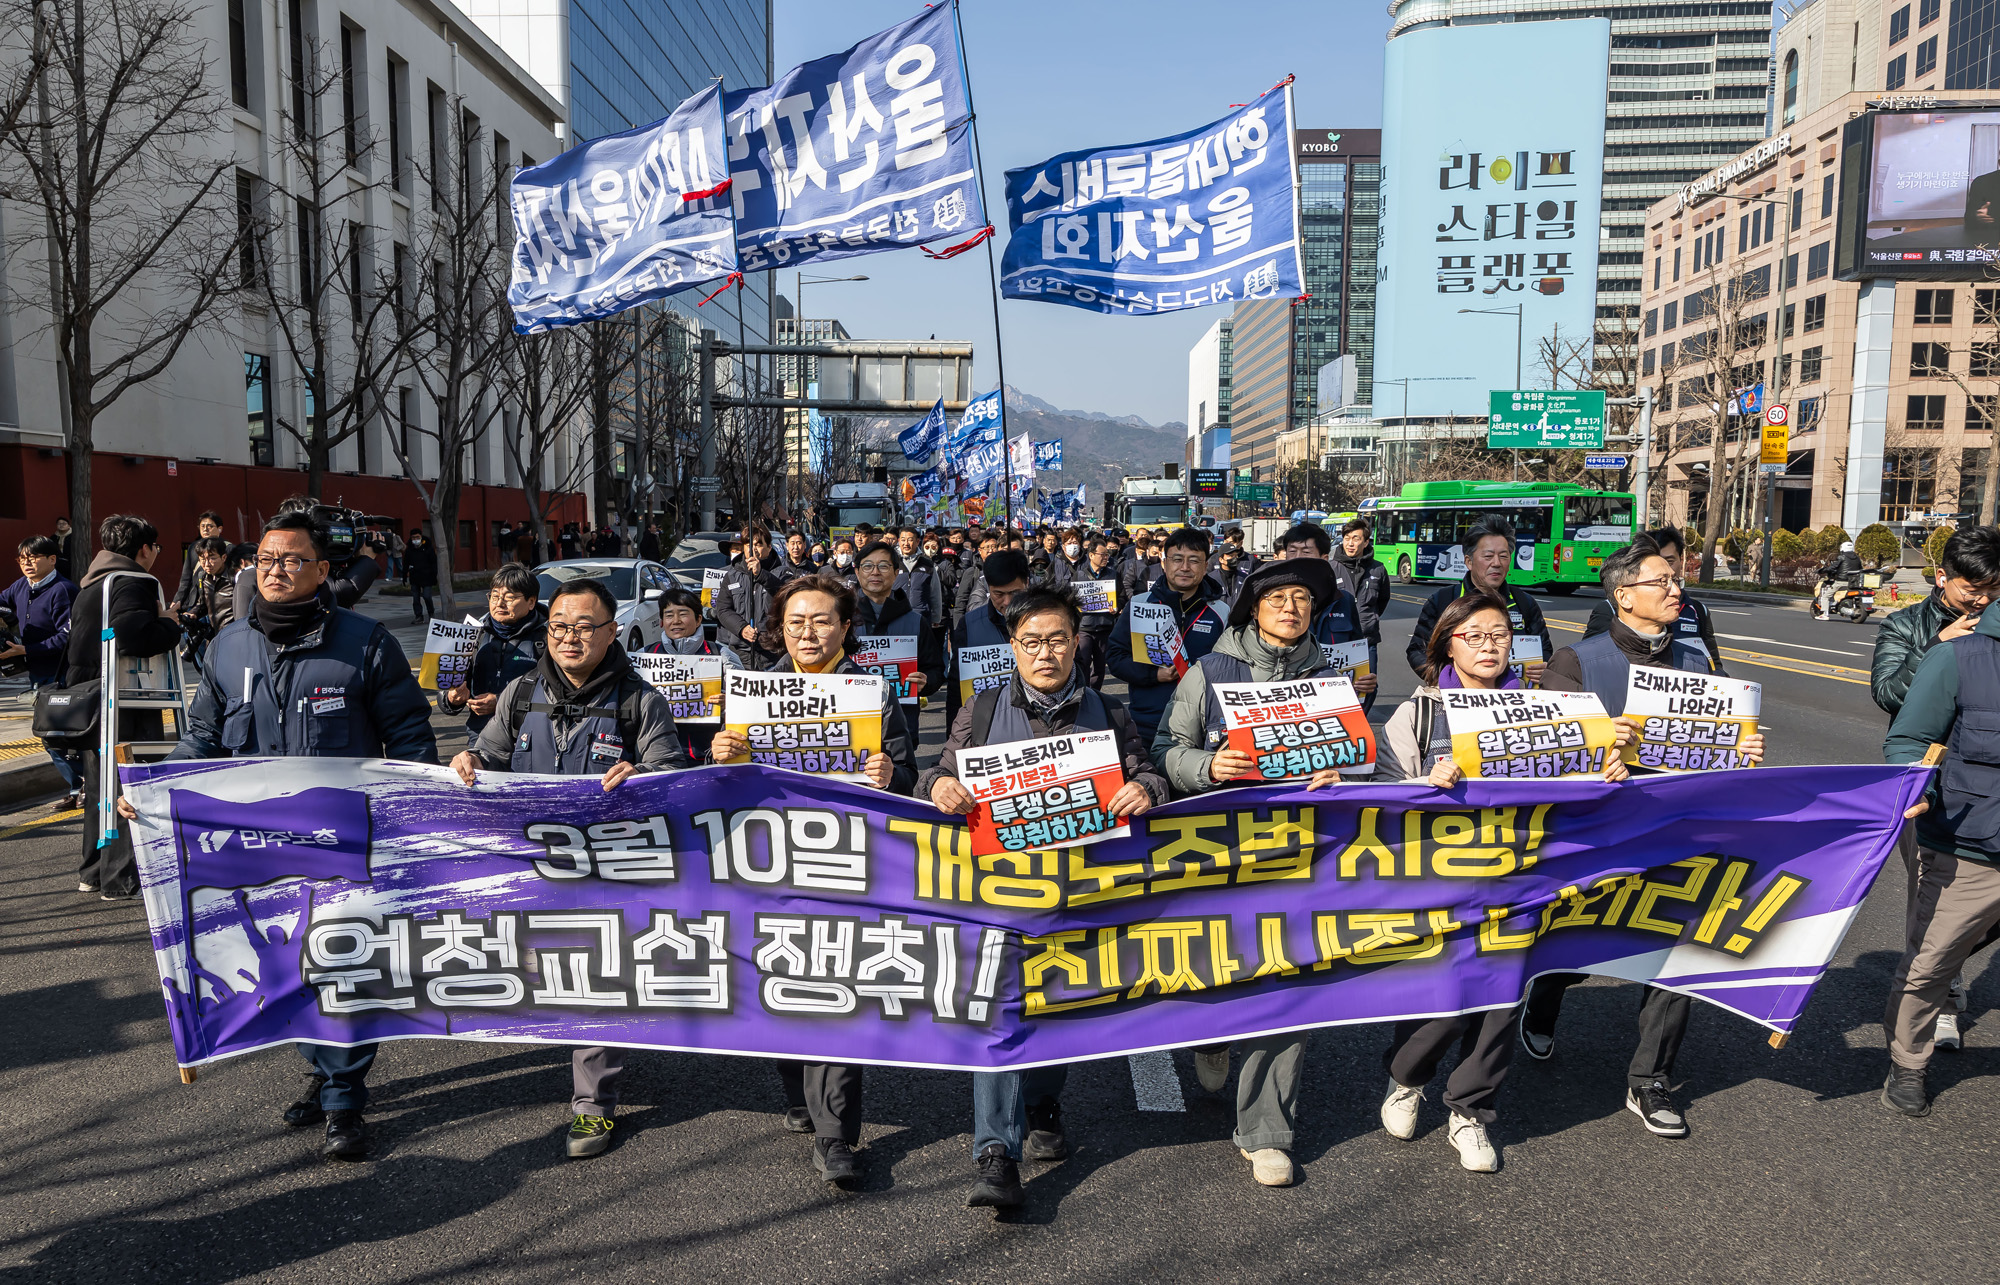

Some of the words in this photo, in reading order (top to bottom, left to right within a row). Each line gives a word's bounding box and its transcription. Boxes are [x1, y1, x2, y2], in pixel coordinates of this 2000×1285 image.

[1879, 95, 1937, 109] 서울신문
[1302, 143, 1338, 152] KYOBO
[1439, 150, 1577, 190] 라이프
[1690, 175, 1716, 199] SEOUL
[1717, 153, 1755, 185] FINANCE
[1755, 133, 1791, 164] CENTER
[1896, 171, 1940, 181] 누구에게나
[1941, 171, 1951, 180] 한
[1952, 170, 1969, 180] 번은
[1923, 180, 1959, 189] 마련이죠
[1436, 200, 1578, 242] 스타일
[1871, 253, 1902, 261] 서울신문
[1944, 250, 1964, 261] 국힘
[1437, 252, 1574, 299] 플랫폼
[1523, 403, 1544, 411] 광화문
[1770, 410, 1784, 419] 50
[1574, 417, 1600, 425] 종로1가
[1614, 514, 1630, 524] 7011
[706, 570, 727, 580] 진짜사
[432, 622, 479, 640] 진짜사장
[454, 641, 479, 653] 나와
[961, 648, 1000, 663] 진짜사장
[438, 654, 473, 672] 원청
[631, 656, 675, 669] 진짜사장
[982, 657, 1015, 674] 나와라
[652, 668, 694, 683] 나와라!
[730, 675, 807, 697] 진짜사장
[1633, 670, 1708, 695] 진짜사장
[655, 684, 702, 702] 청교섭
[1222, 690, 1258, 706] 모든
[1256, 681, 1317, 704] 노동자의
[1448, 693, 1526, 709] 진짜사장
[767, 694, 837, 719] 나와라!
[1233, 703, 1308, 726] 노동기본권
[1492, 703, 1563, 725] 나와라!
[1668, 697, 1733, 717] 나와라!
[747, 720, 851, 750] 원청교섭
[1087, 734, 1111, 743] 민주노총
[1251, 716, 1350, 752] 투쟁으로
[1477, 720, 1586, 759] 원청교섭
[1642, 716, 1740, 747] 원청교섭
[965, 756, 1003, 777] 모든
[1005, 738, 1075, 770] 노동자의
[1257, 736, 1367, 779] 쟁취하자!
[1638, 742, 1751, 770] 쟁취하자!
[973, 763, 1059, 800] 노동기본권
[990, 778, 1099, 825] 투쟁으로
[240, 828, 339, 850] 민주노총
[996, 807, 1116, 851] 쟁취하자!
[525, 814, 676, 881] 3월
[692, 807, 868, 893] 10일
[887, 805, 1316, 910] 개정노조법
[1338, 802, 1556, 880] 시행!
[306, 912, 730, 1015] 원청교섭
[755, 916, 1006, 1022] 쟁취!
[1021, 908, 1463, 1019] 진짜사장
